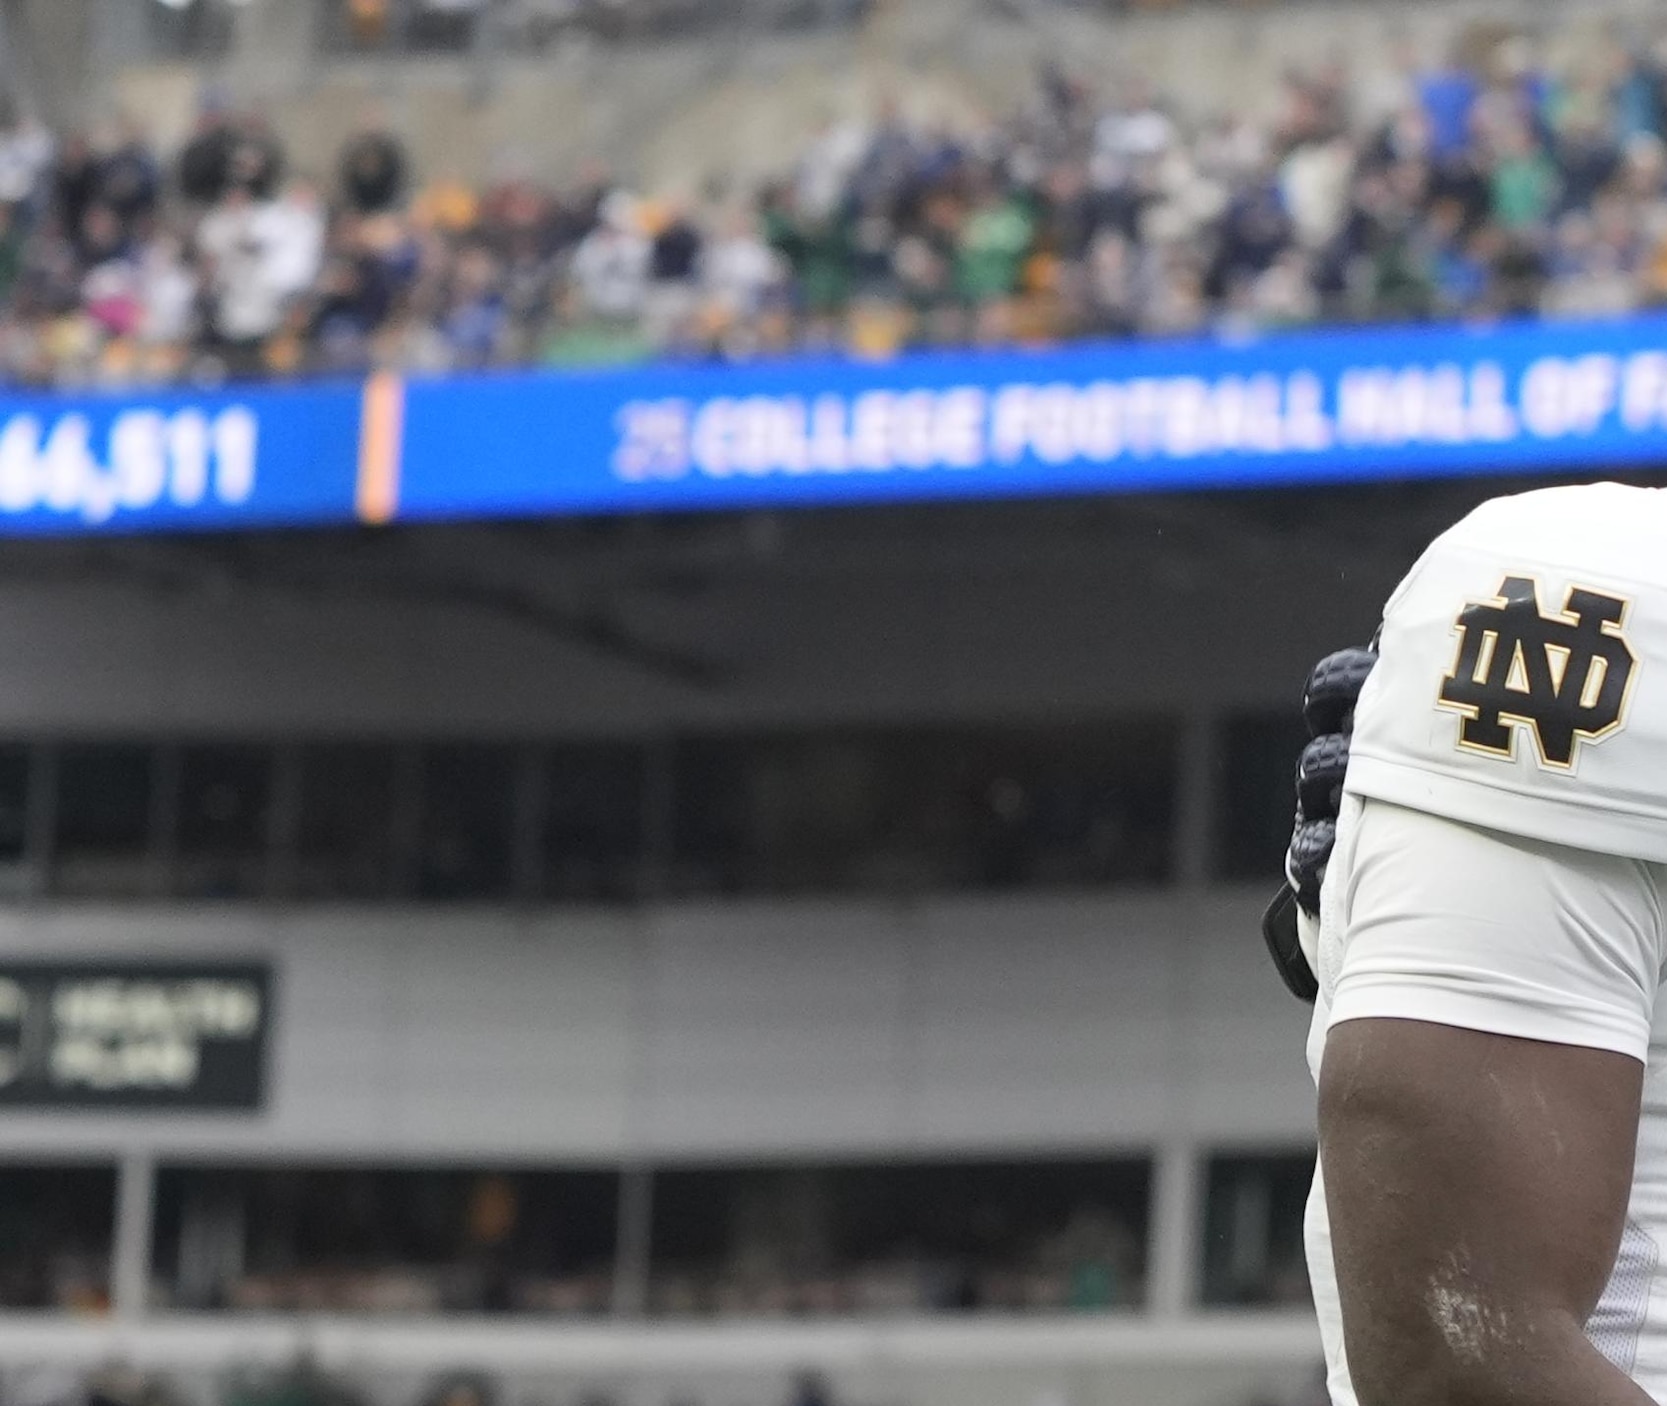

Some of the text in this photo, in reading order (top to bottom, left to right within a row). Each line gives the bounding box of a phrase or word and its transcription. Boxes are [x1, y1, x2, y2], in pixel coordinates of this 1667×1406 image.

[693, 385, 985, 478] COLLEGE
[992, 369, 1333, 466] FOOTBALL
[1337, 360, 1518, 446] HALL
[1519, 353, 1618, 440] OF
